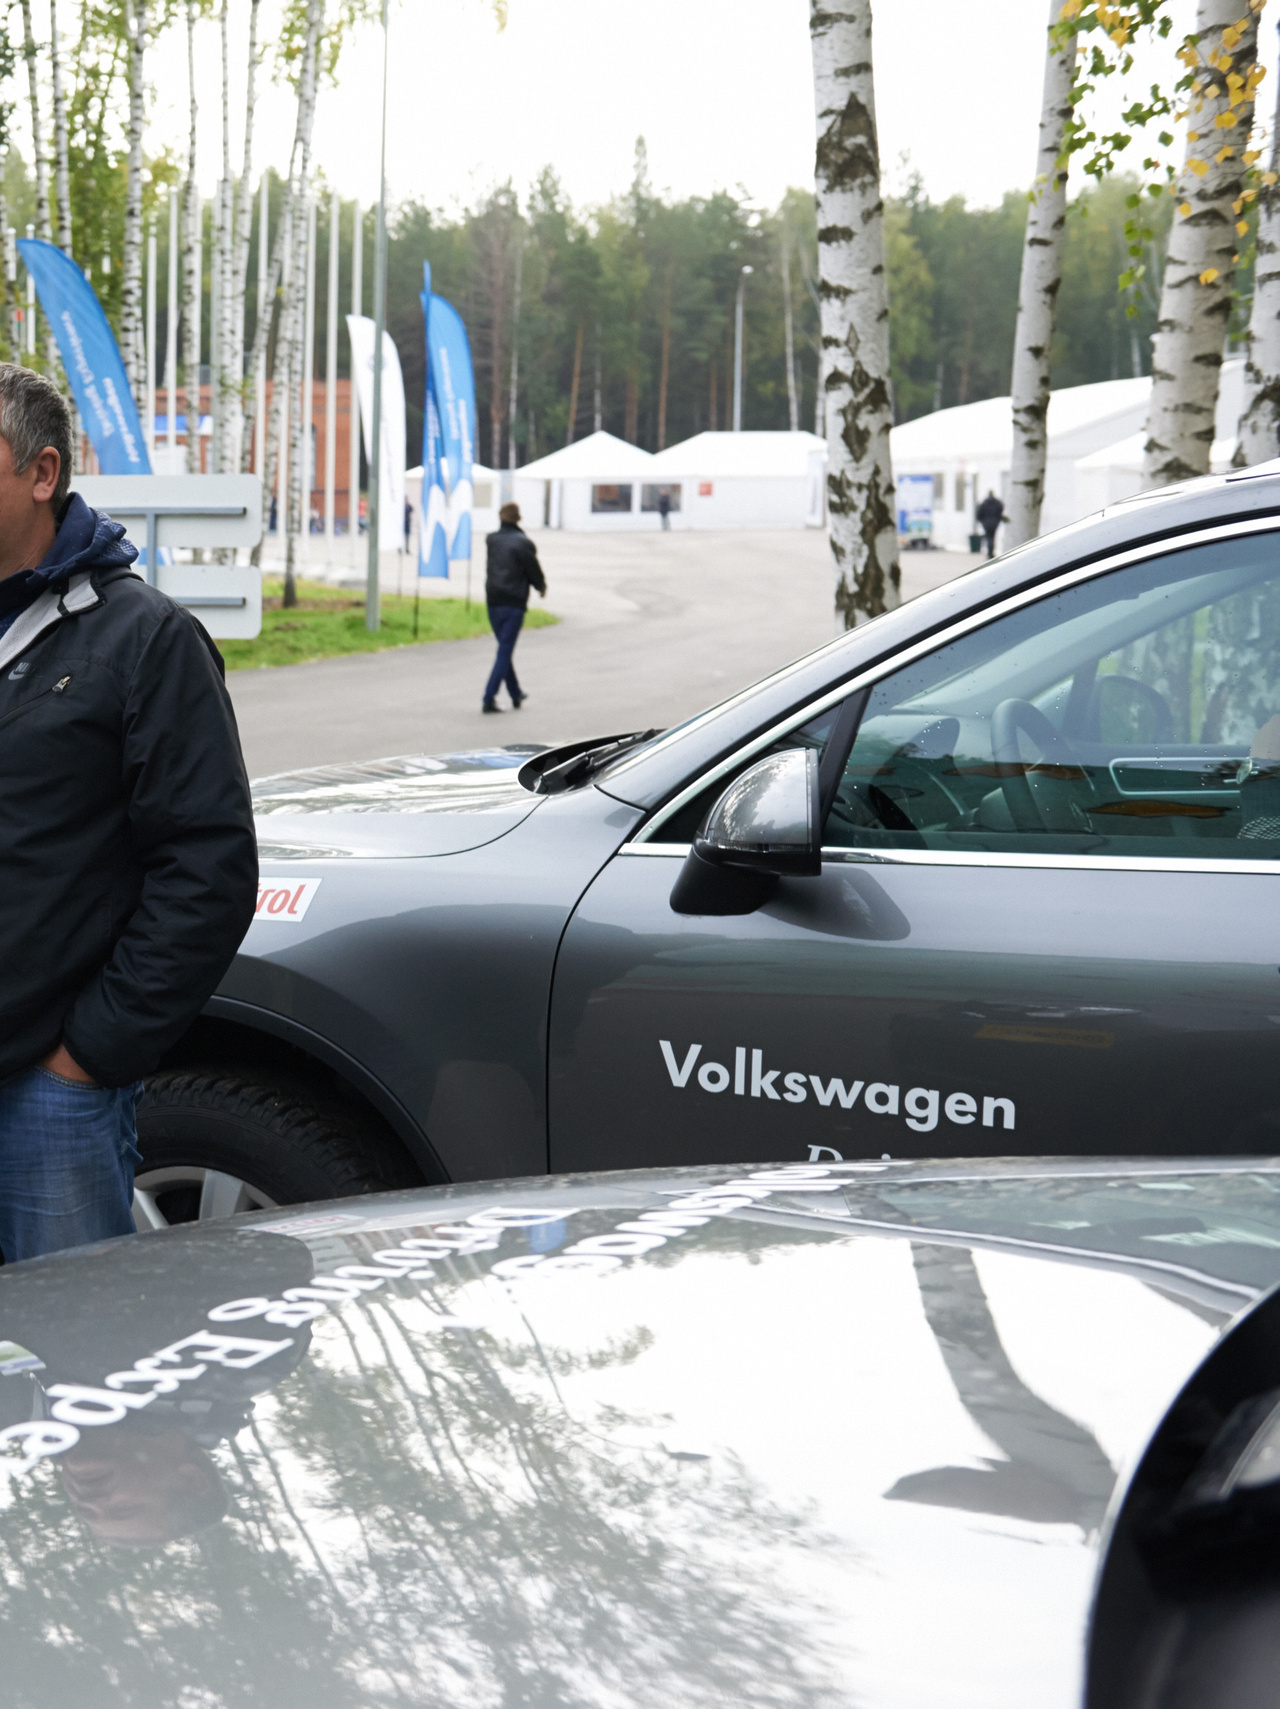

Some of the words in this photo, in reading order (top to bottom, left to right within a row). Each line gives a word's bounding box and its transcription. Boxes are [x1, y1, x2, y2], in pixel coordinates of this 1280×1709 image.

[256, 883, 307, 915] rol
[658, 1039, 1017, 1133] Volkswagen
[207, 1206, 580, 1328] Driving
